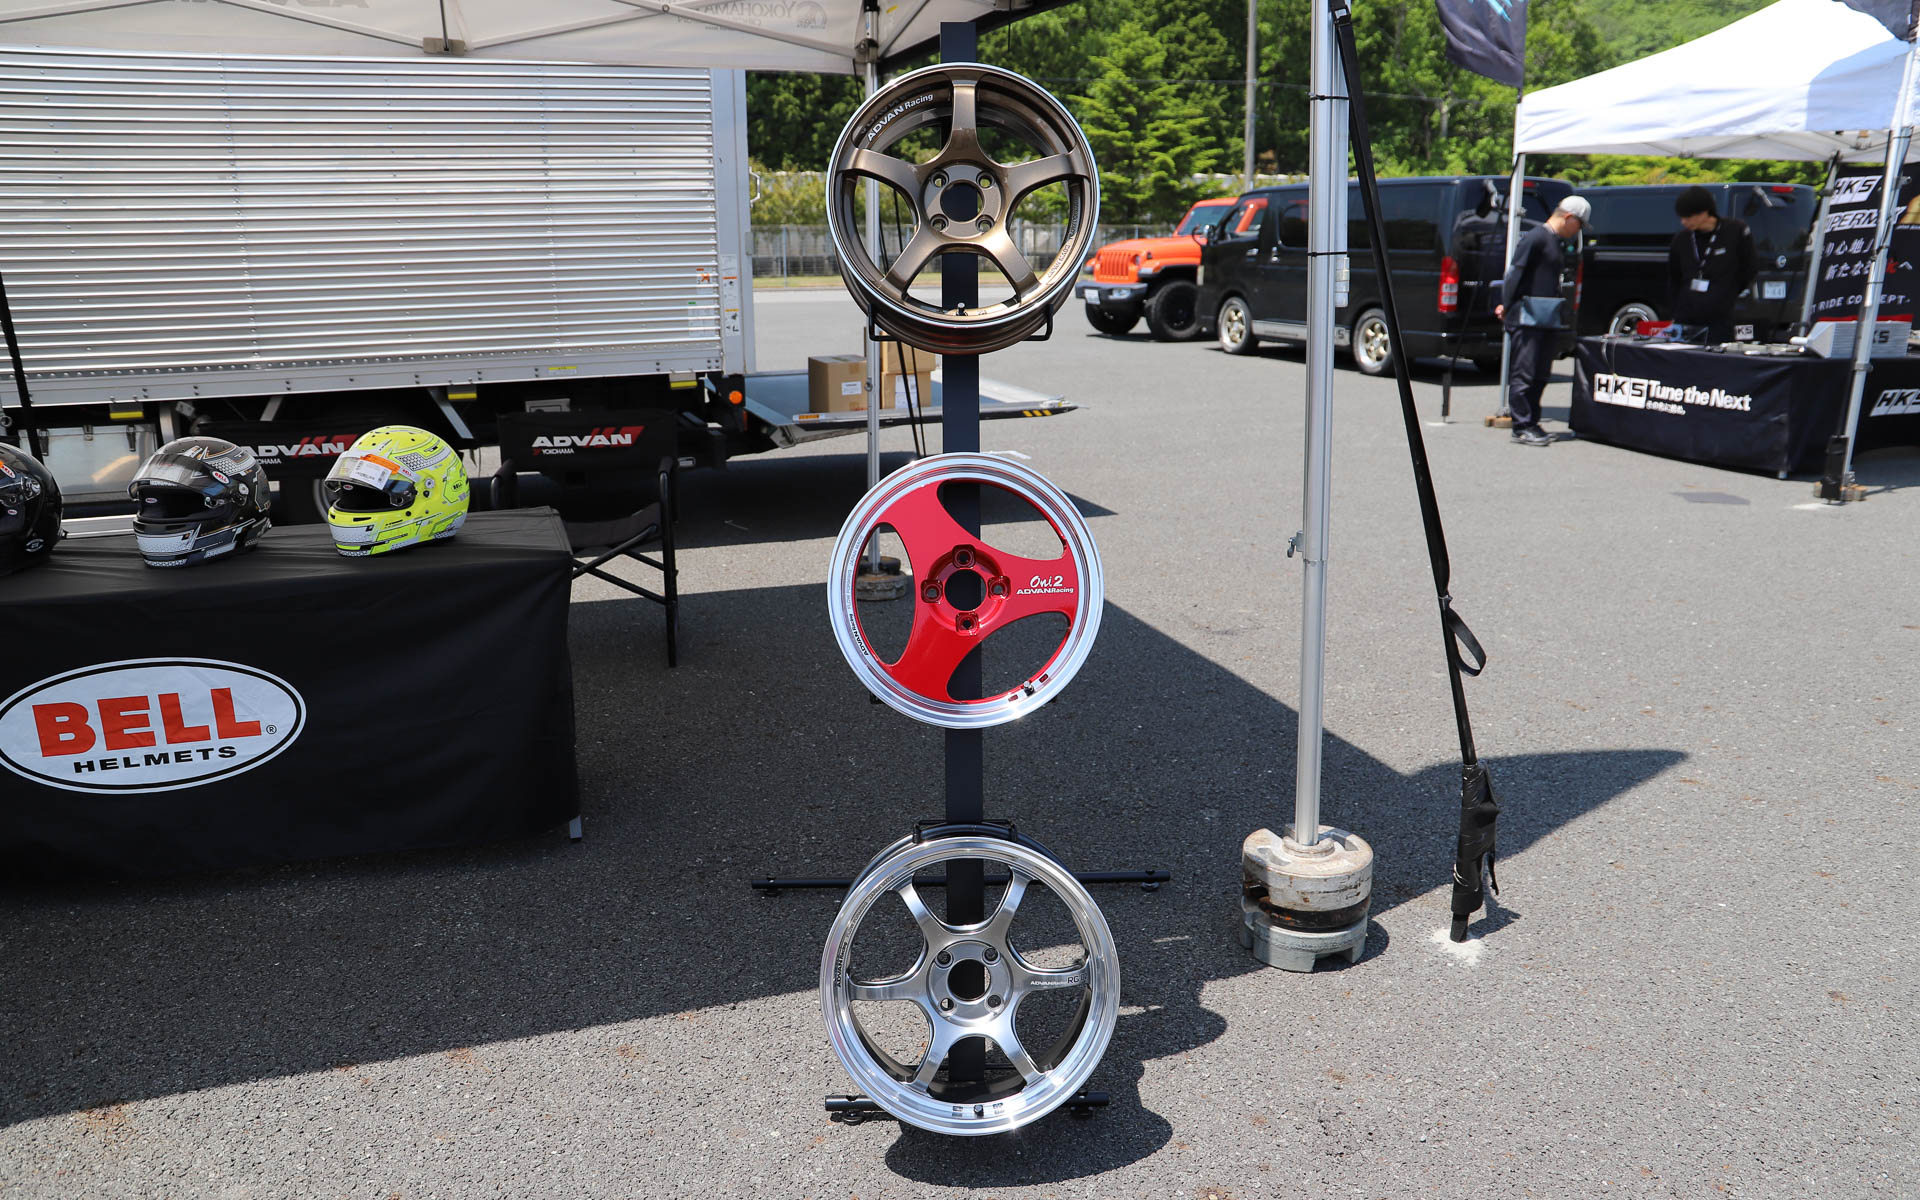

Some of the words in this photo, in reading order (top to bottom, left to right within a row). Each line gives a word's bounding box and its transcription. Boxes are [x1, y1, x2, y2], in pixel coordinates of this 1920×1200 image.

[867, 106, 905, 141] ADVAN
[1819, 296, 1845, 311] RIDE
[1596, 375, 1646, 400] HKS
[1649, 380, 1684, 402] Tune
[1684, 386, 1710, 405] the
[1709, 389, 1752, 412] Next
[240, 442, 345, 457] ADVAN
[532, 434, 632, 447] ADVAN
[542, 448, 574, 456] YOKOHAMA
[32, 688, 262, 758] BELL
[74, 746, 237, 773] HELMETS
